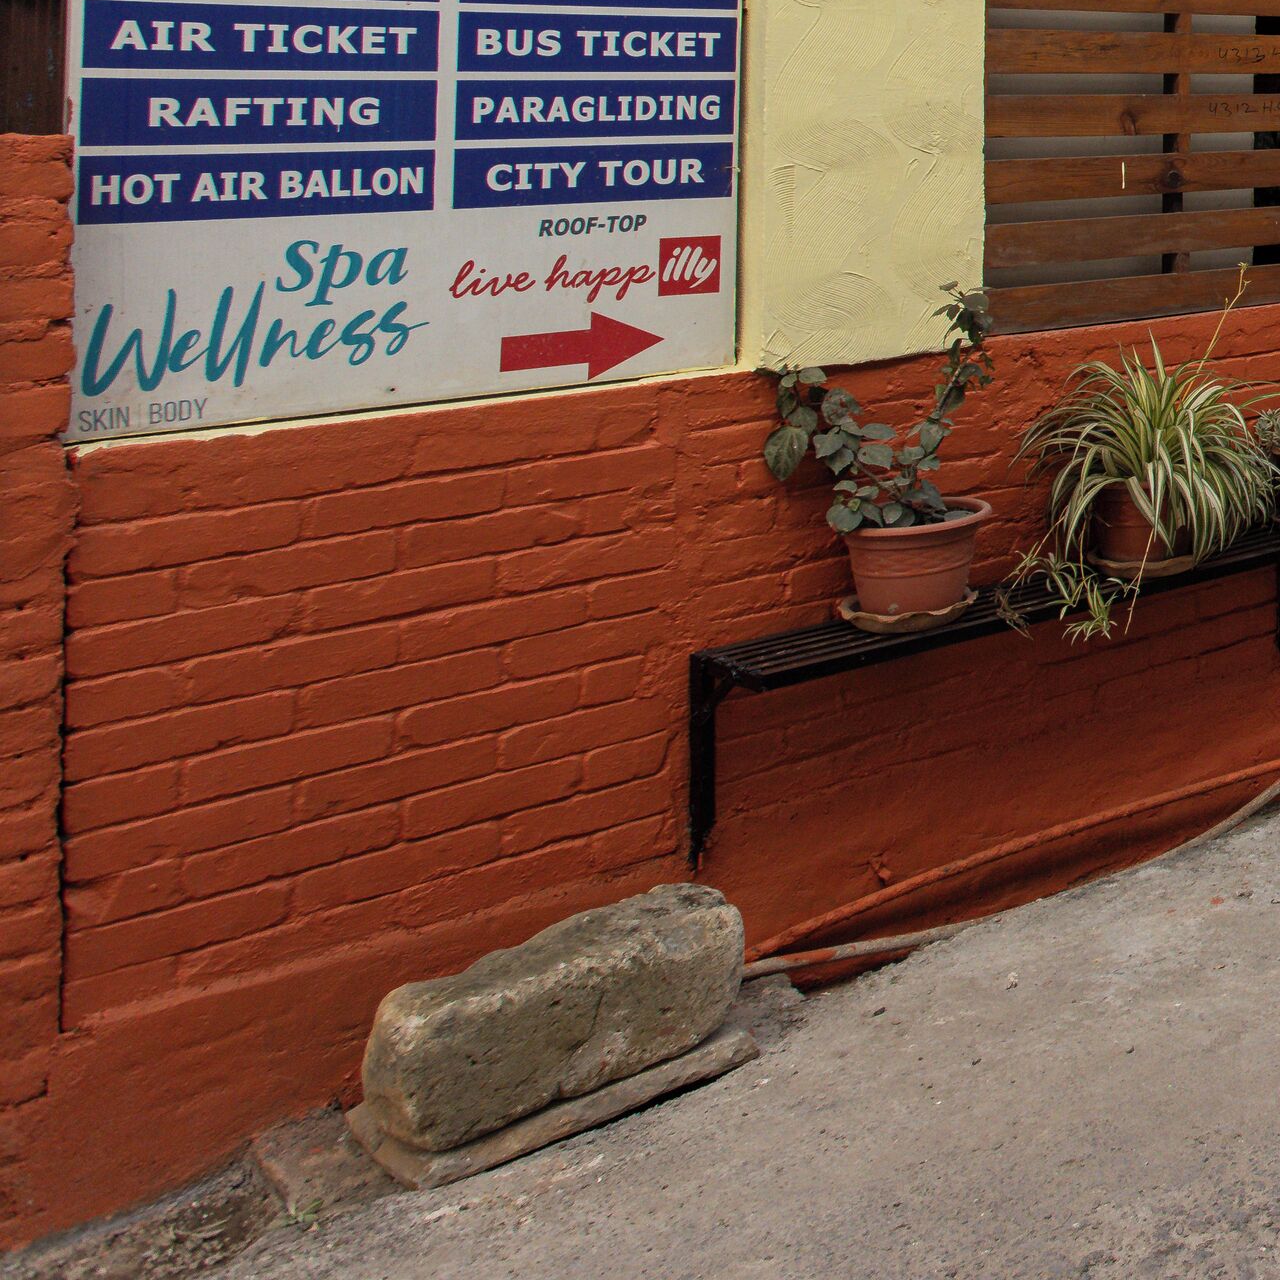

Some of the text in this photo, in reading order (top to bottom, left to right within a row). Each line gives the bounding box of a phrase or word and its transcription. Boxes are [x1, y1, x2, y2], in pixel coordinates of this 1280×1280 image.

[110, 20, 417, 55] AIR TICKET
[476, 29, 721, 58] BUS TICKET
[148, 96, 381, 129] RAFTING
[472, 95, 720, 124] PARAGLIDING
[92, 167, 424, 206] HOT AIR BALLON
[486, 159, 704, 192] CITY TOUR
[539, 214, 647, 237] ROOF-TOP
[275, 239, 409, 307] Spa
[449, 245, 718, 304] live happ illy
[81, 280, 431, 397] Wellness
[78, 397, 209, 433] SKIN BODY
